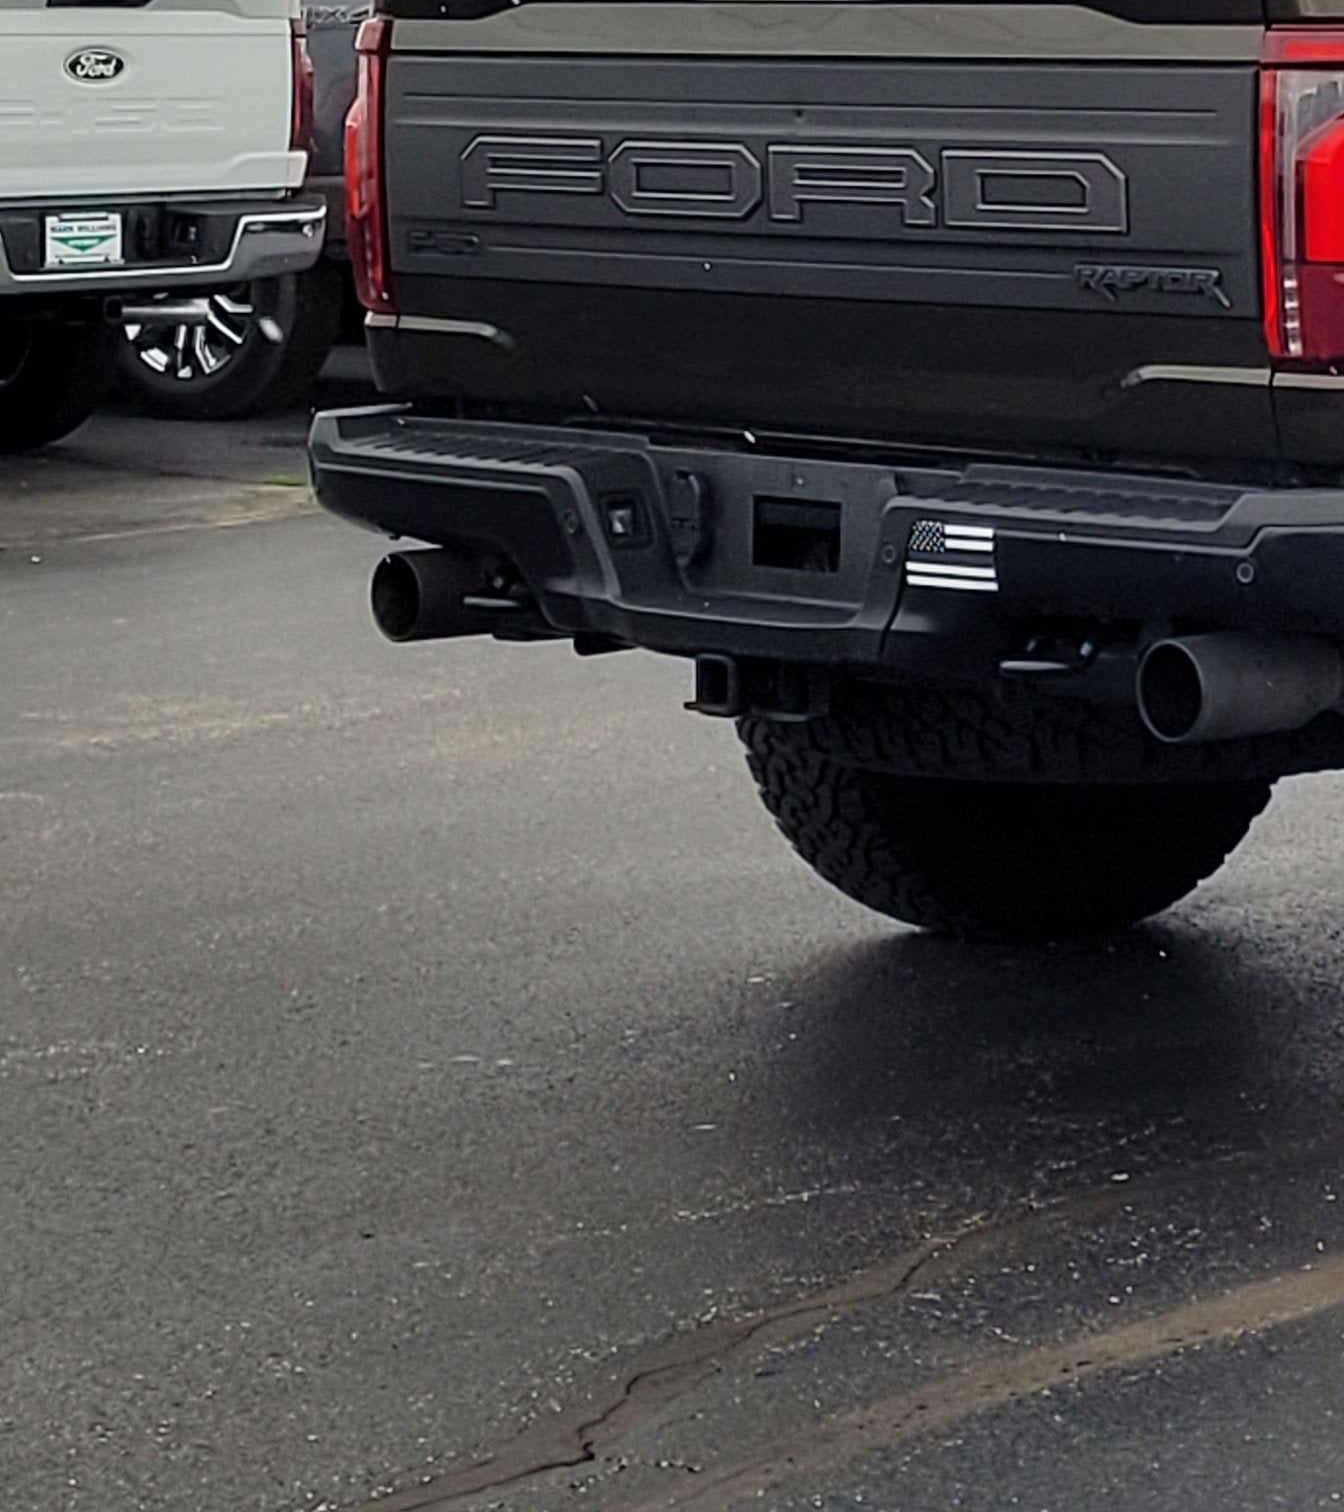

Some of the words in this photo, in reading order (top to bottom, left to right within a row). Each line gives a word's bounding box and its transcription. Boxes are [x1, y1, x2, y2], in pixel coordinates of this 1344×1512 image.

[76, 53, 117, 77] Ford
[460, 134, 1130, 234] FORD
[1074, 263, 1232, 308] RAPTOR
